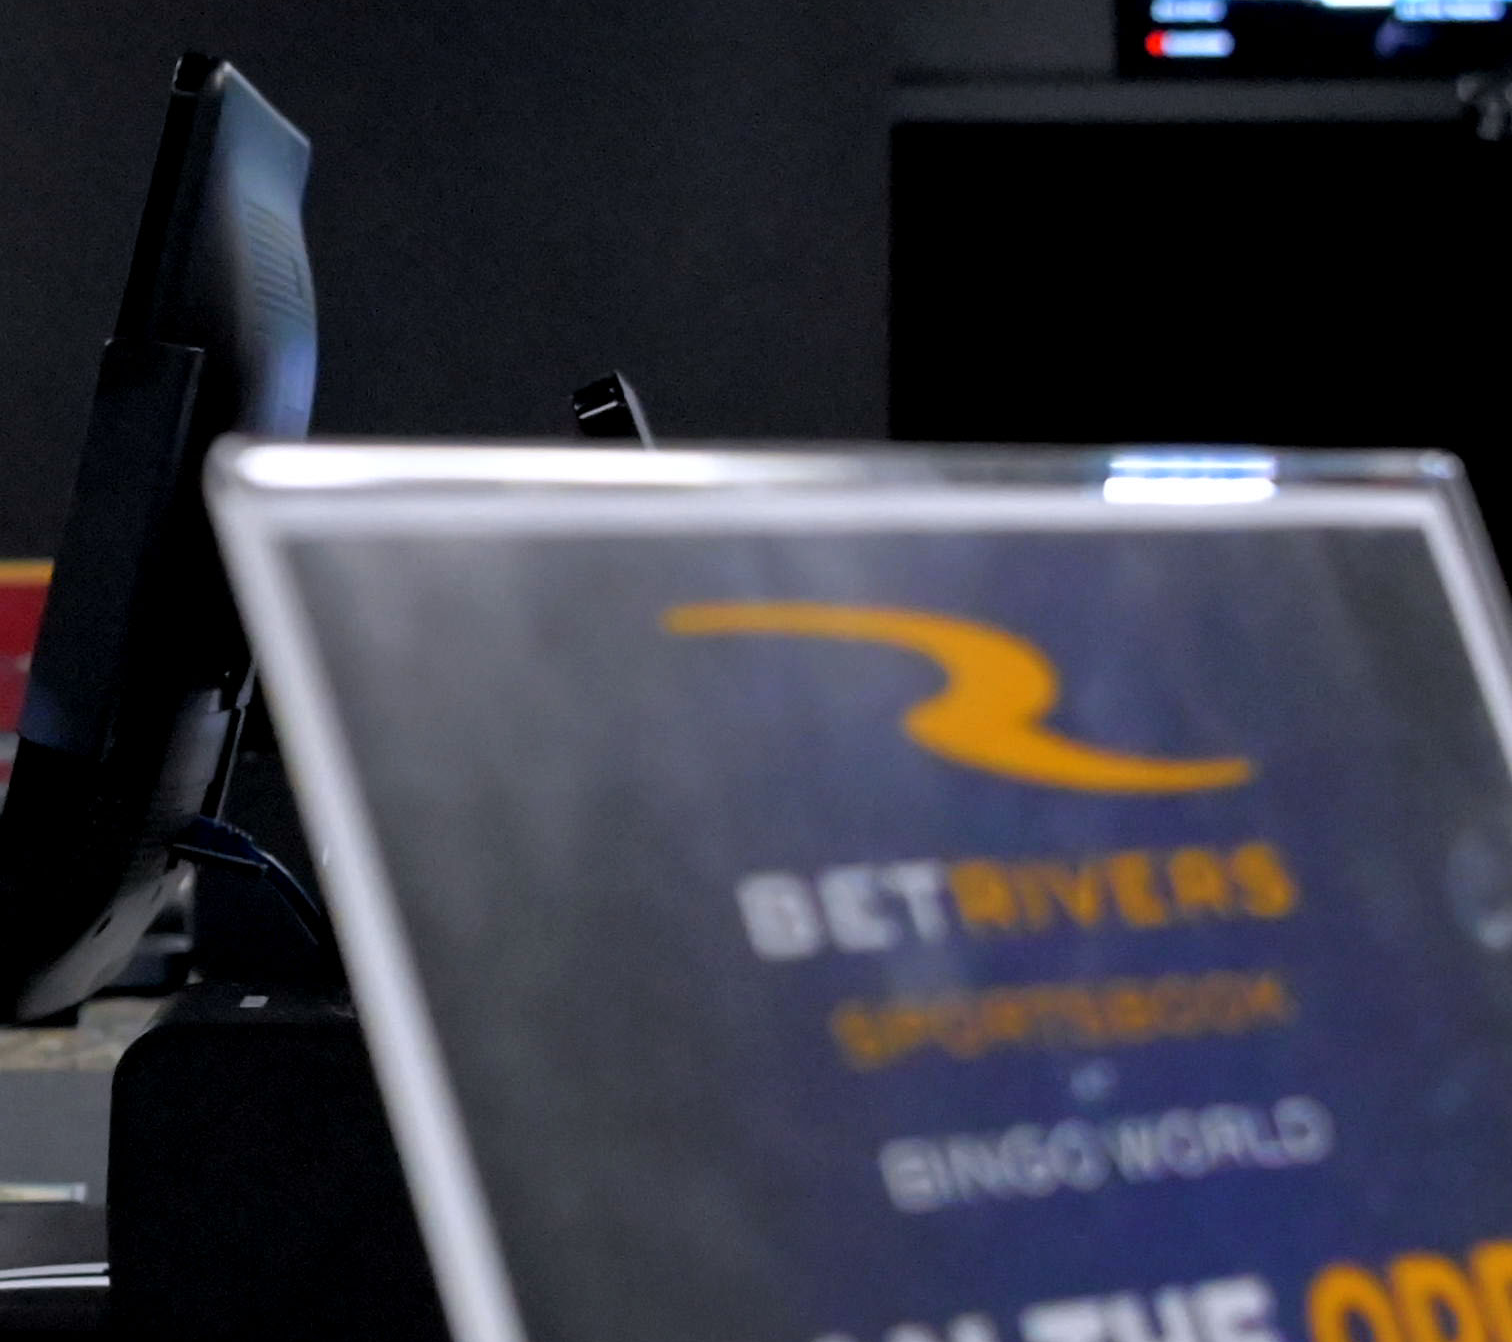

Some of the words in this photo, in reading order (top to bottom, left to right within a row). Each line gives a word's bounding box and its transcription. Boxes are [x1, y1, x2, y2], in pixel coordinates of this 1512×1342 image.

[739, 848, 1293, 954] BETRIVERS
[834, 975, 1291, 1063] SPORTSBOOK
[884, 1122, 1104, 1207] BINGO
[1108, 1102, 1329, 1178] WORLD
